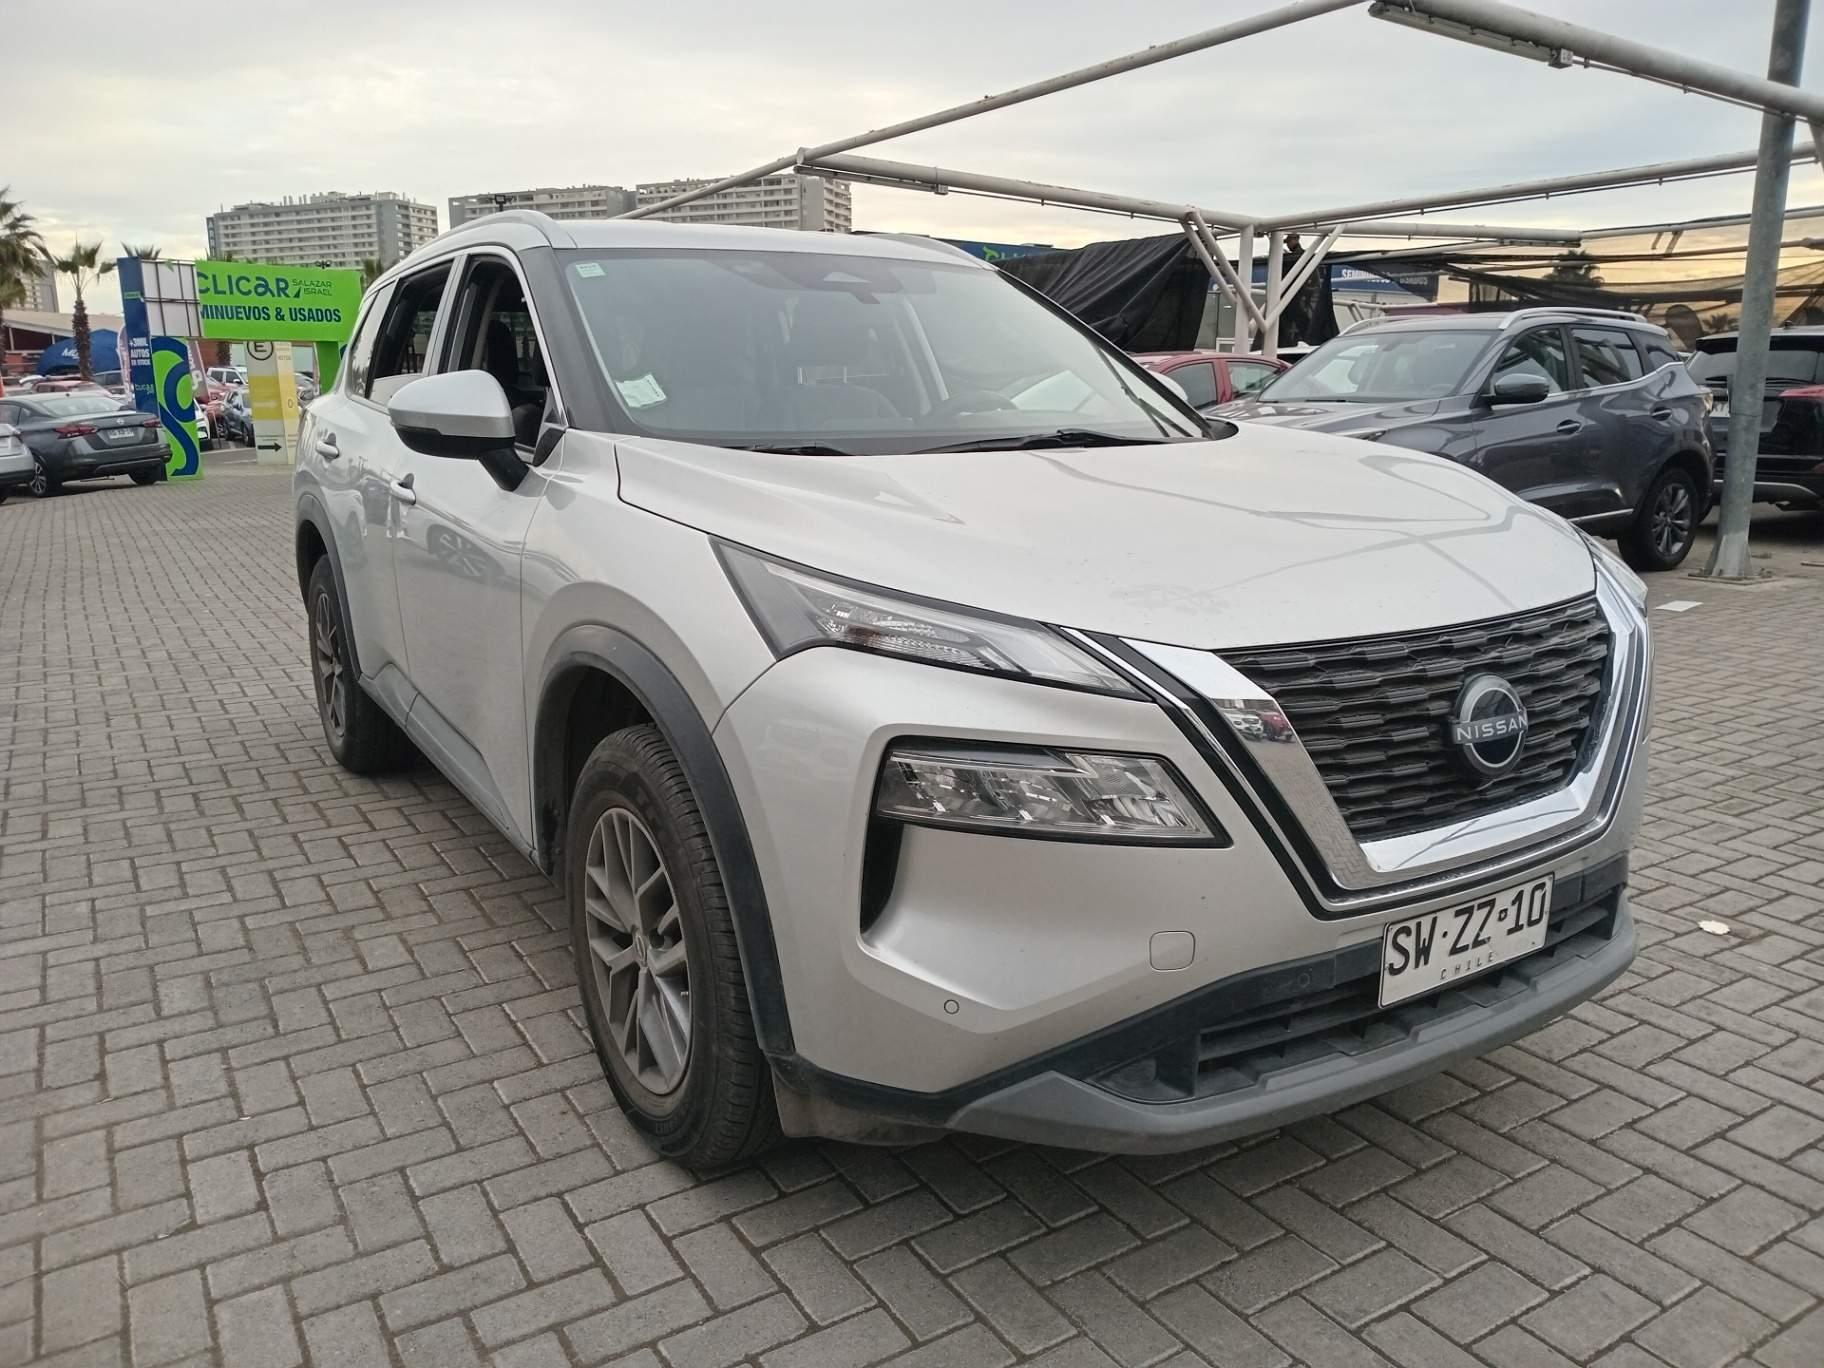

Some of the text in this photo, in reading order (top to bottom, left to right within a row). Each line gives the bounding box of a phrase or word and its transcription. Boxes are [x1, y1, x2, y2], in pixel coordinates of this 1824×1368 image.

[292, 278, 332, 288] SALAZAR
[303, 288, 333, 296] ISRAEL
[275, 307, 285, 321] &
[289, 307, 342, 323] USADOS
[130, 348, 150, 358] AUTOS
[1456, 714, 1527, 741] NISSAN
[1440, 952, 1497, 980] CHILE
